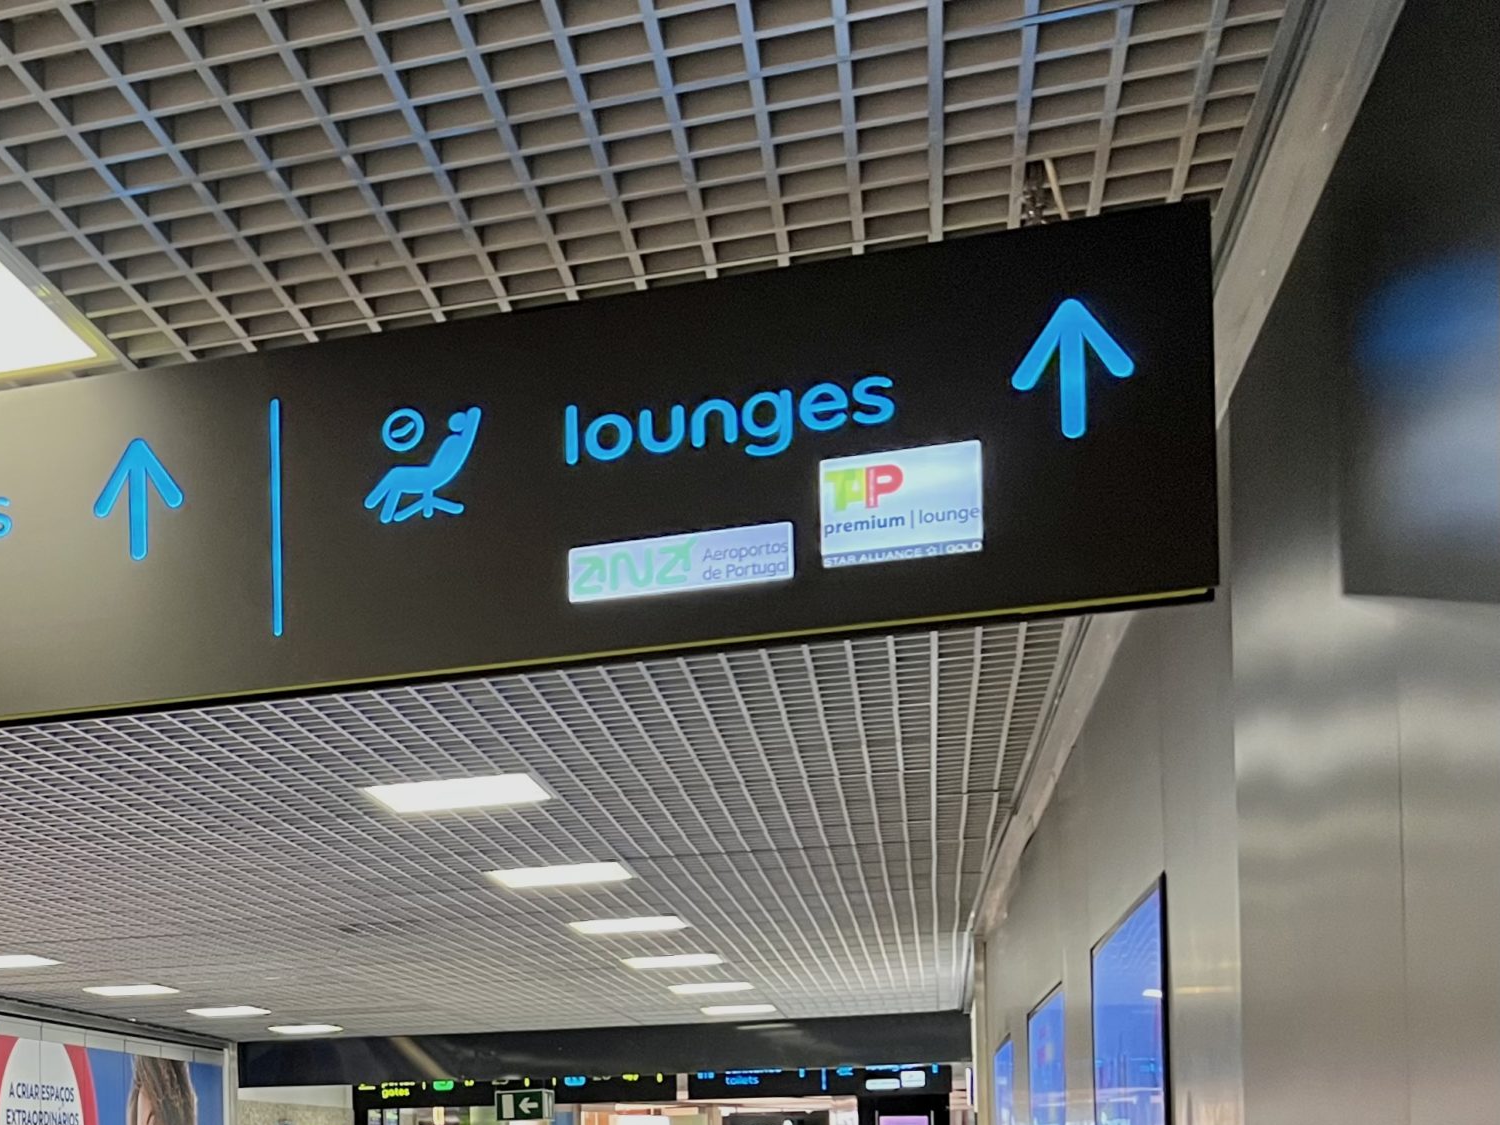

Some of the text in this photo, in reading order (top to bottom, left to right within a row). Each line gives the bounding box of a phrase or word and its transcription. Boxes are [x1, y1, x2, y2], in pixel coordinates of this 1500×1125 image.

[564, 373, 896, 466] lounges
[824, 464, 904, 513] TAP
[824, 507, 980, 537] premium lounge
[703, 541, 789, 562] Aeroportos
[824, 541, 982, 566] STAR ALLIANCE GOLD
[703, 558, 789, 580] de Portugal
[725, 1075, 760, 1085] toilets
[9, 1082, 74, 1107] A CRIAR ESPAÇOS
